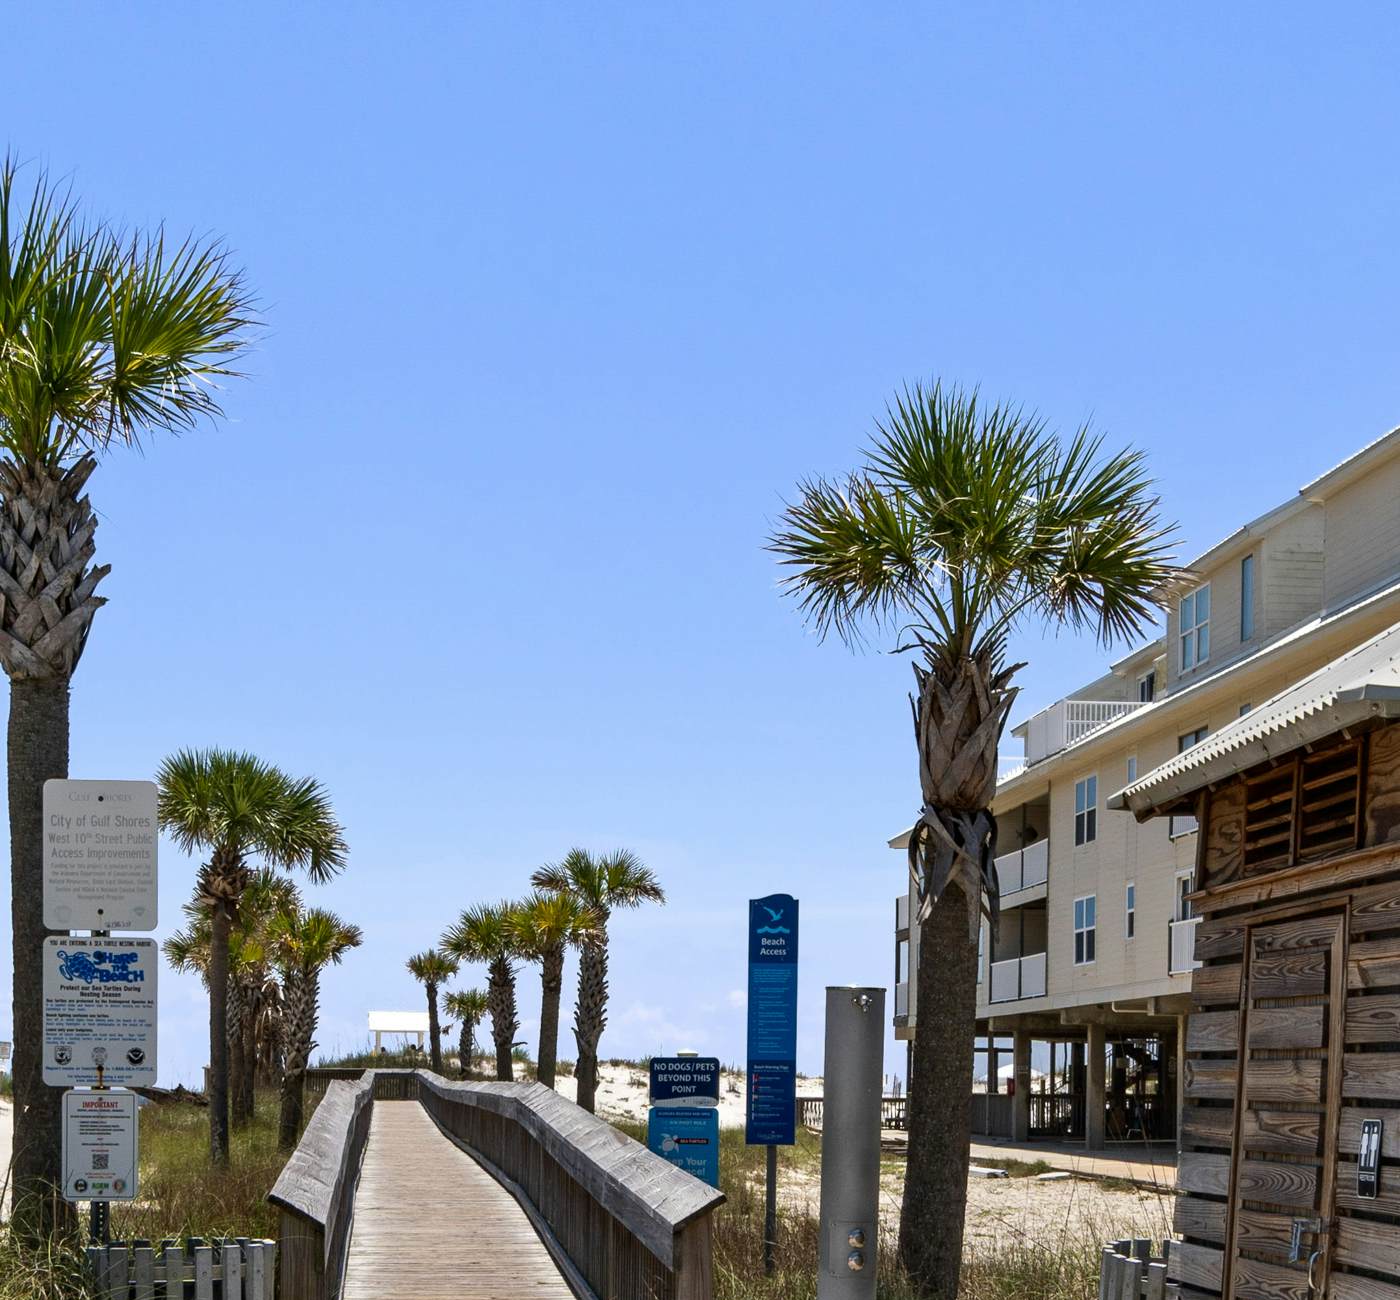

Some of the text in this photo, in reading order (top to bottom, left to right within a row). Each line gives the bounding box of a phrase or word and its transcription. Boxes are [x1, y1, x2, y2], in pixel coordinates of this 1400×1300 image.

[50, 815, 150, 829] City of Gulf Shores
[48, 833, 70, 844] West
[95, 833, 123, 844] Street
[127, 833, 152, 844] Public
[51, 847, 150, 861] Access Improvements
[761, 937, 786, 946] Beach
[760, 947, 787, 956] Access
[654, 1062, 716, 1072] NO DOGS/PETS
[657, 1073, 711, 1082] BEYOND THIS
[671, 1085, 697, 1093] POINT
